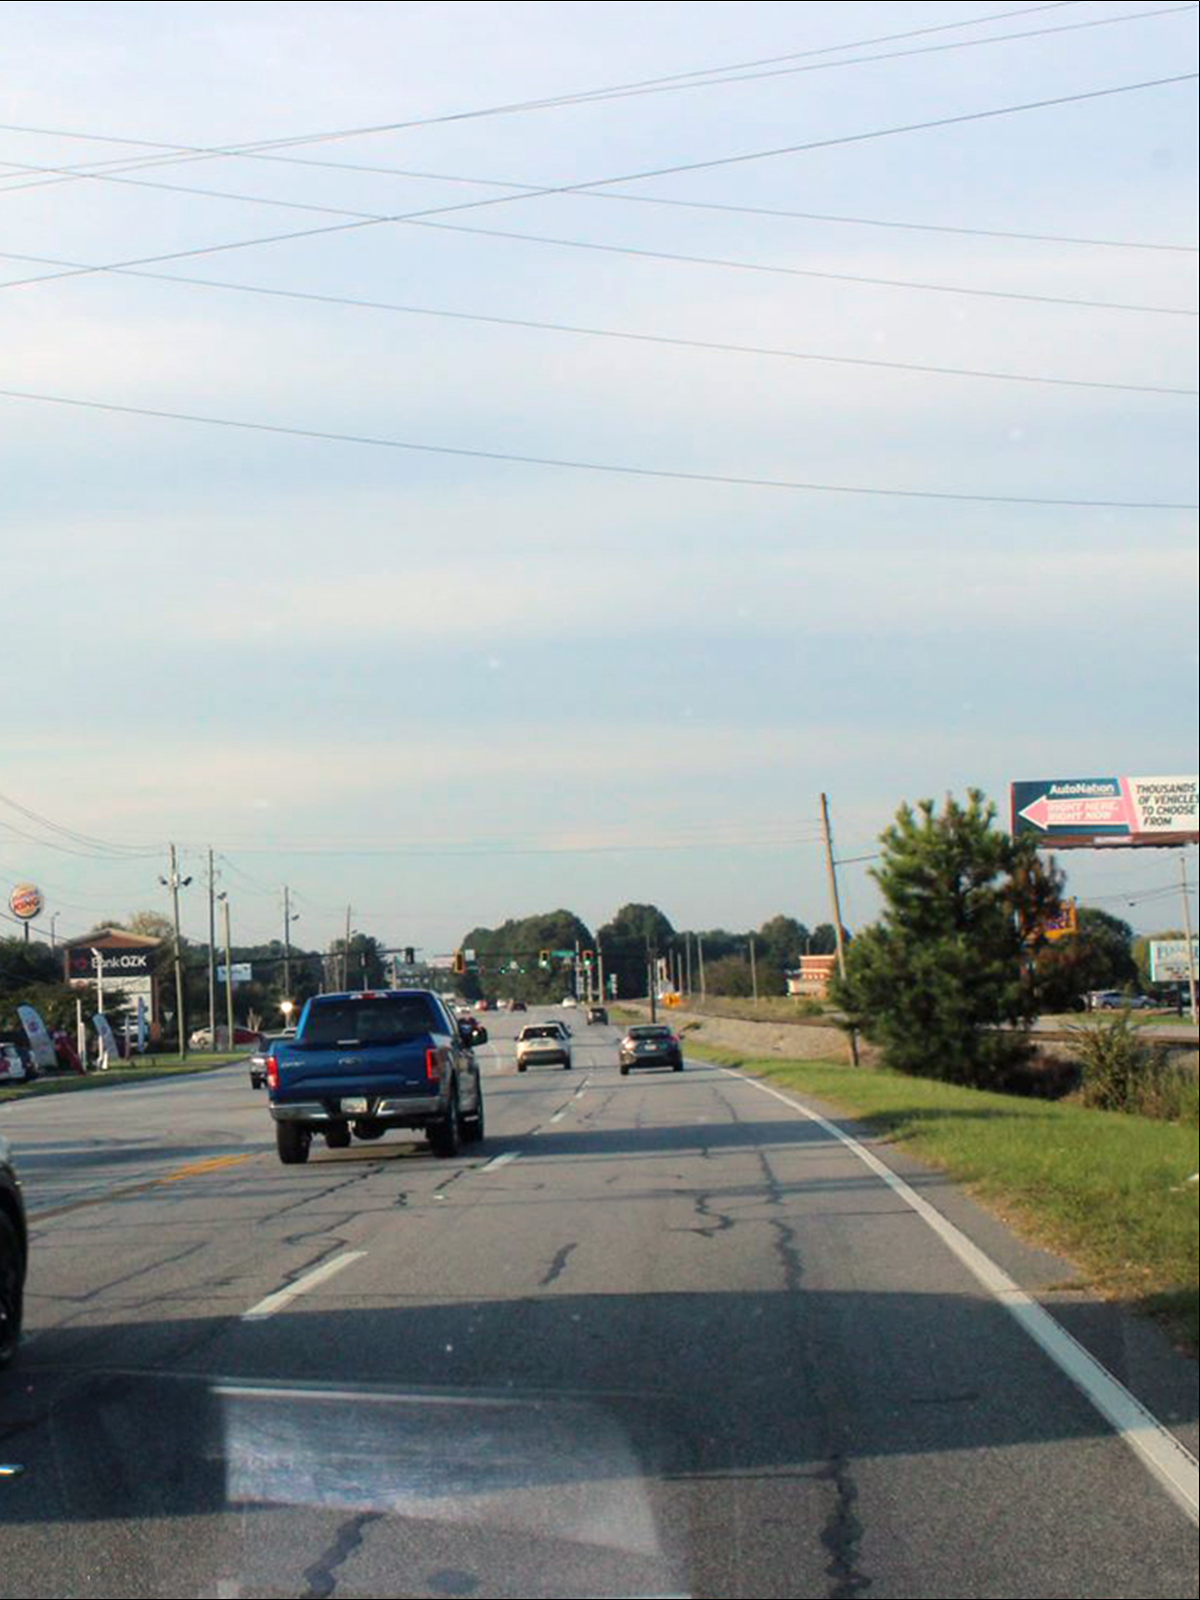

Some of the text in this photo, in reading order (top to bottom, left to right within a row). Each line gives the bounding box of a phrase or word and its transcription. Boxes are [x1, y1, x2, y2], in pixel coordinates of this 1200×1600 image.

[1050, 783, 1115, 795] AutoNation
[1136, 782, 1196, 794] THOUSANDS
[1138, 795, 1153, 805] OF
[1142, 803, 1196, 816] TO CHOOSE
[1144, 816, 1172, 827] FROM
